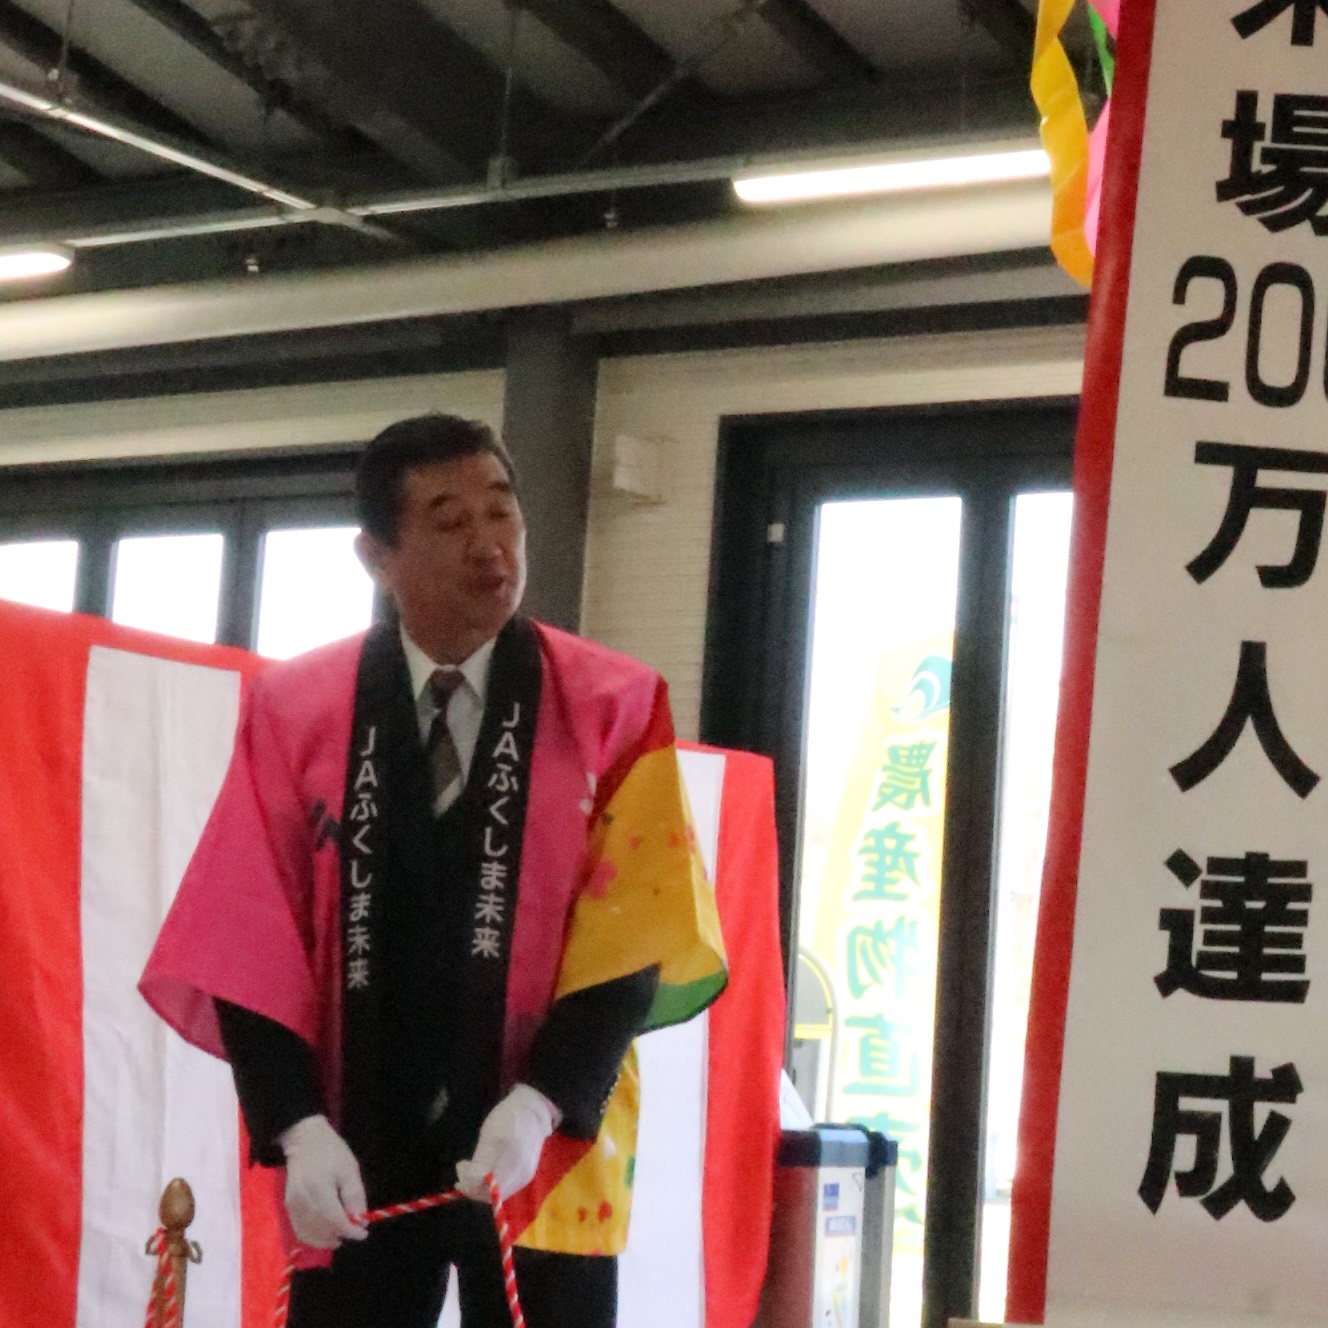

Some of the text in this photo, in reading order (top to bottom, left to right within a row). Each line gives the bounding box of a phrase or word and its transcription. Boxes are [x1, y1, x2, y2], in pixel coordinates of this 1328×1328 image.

[347, 726, 378, 989] JAふくしま未来
[471, 702, 521, 959] JAふくしま未来
